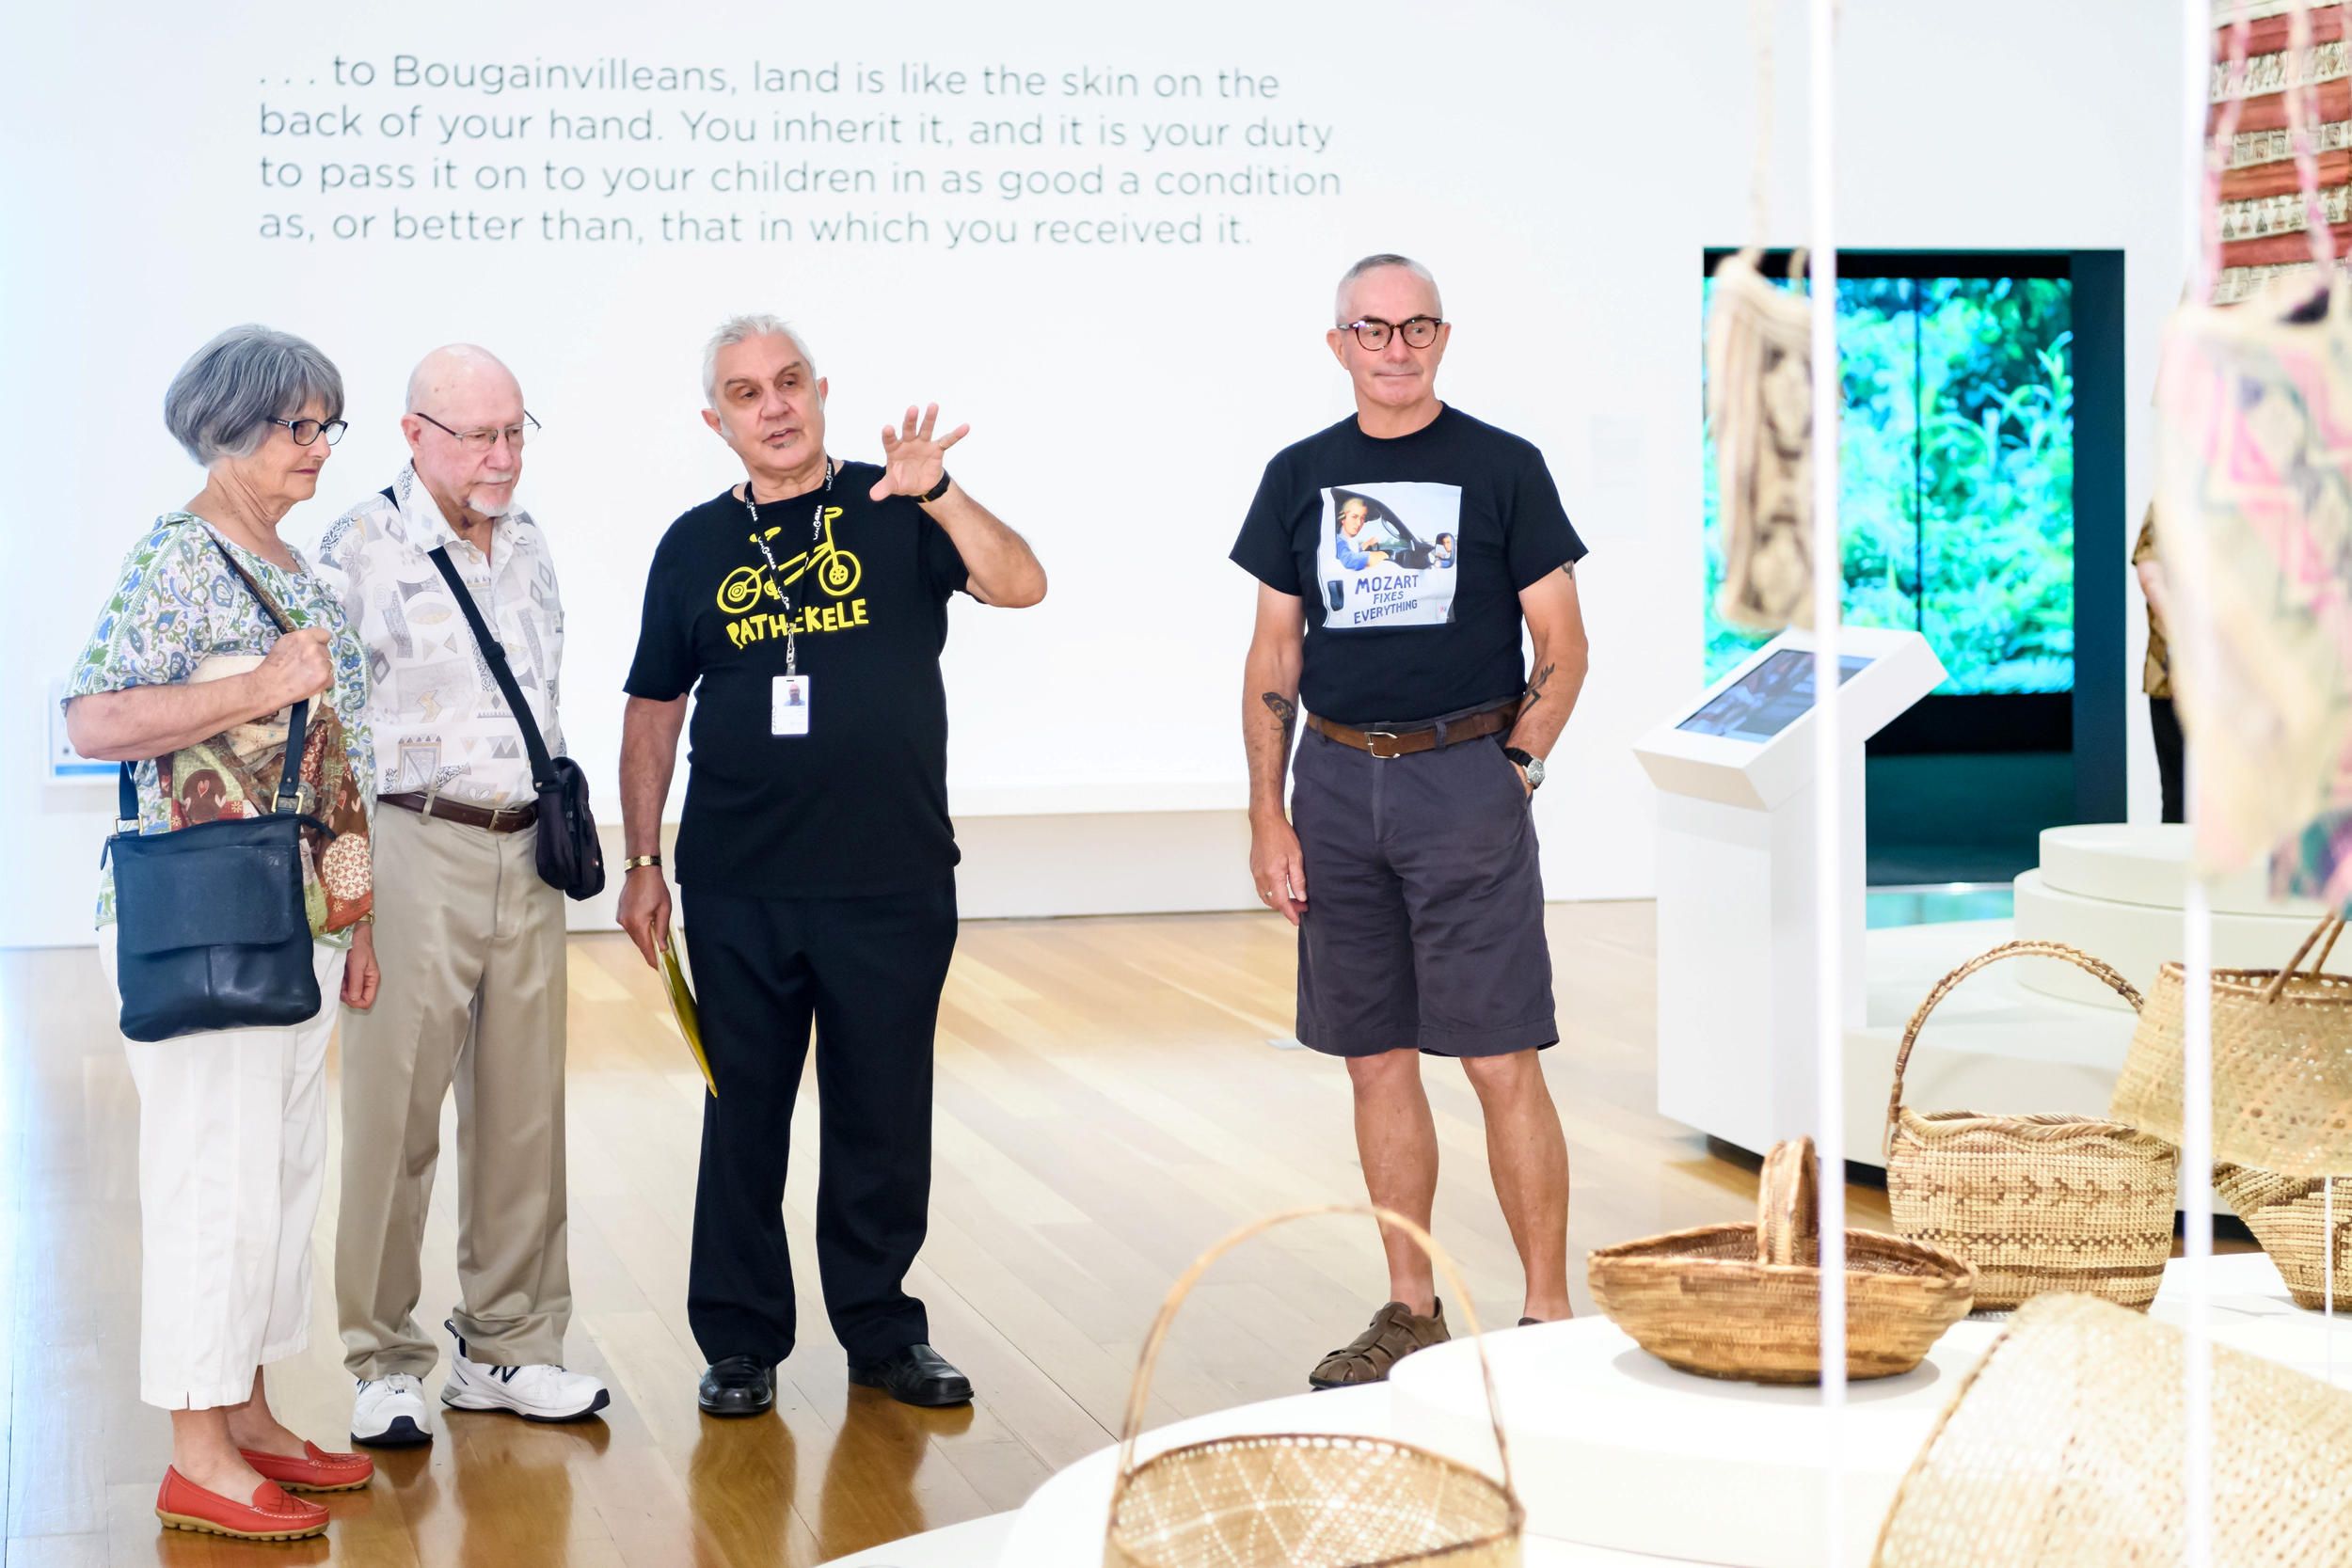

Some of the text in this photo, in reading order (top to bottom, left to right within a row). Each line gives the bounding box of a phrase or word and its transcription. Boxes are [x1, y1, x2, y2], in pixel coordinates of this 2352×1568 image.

[331, 55, 376, 87] to
[393, 55, 737, 96] Bougainvilleans,
[755, 60, 839, 93] land
[857, 62, 885, 94] is
[901, 62, 967, 95] like
[982, 64, 1046, 96] the
[1062, 65, 1138, 96] skin
[1153, 74, 1201, 98] on
[1217, 68, 1279, 100] the
[260, 102, 1332, 154] back of your hand. You inherit it, and it is your duty
[260, 156, 1340, 201] to pass it on to your children in as good a condition
[259, 207, 1250, 250] as, or better than, that in which you received it.
[1355, 575, 1419, 594] MOZART
[1373, 591, 1404, 605] FIXES
[1354, 599, 1418, 625] EVERYTHING
